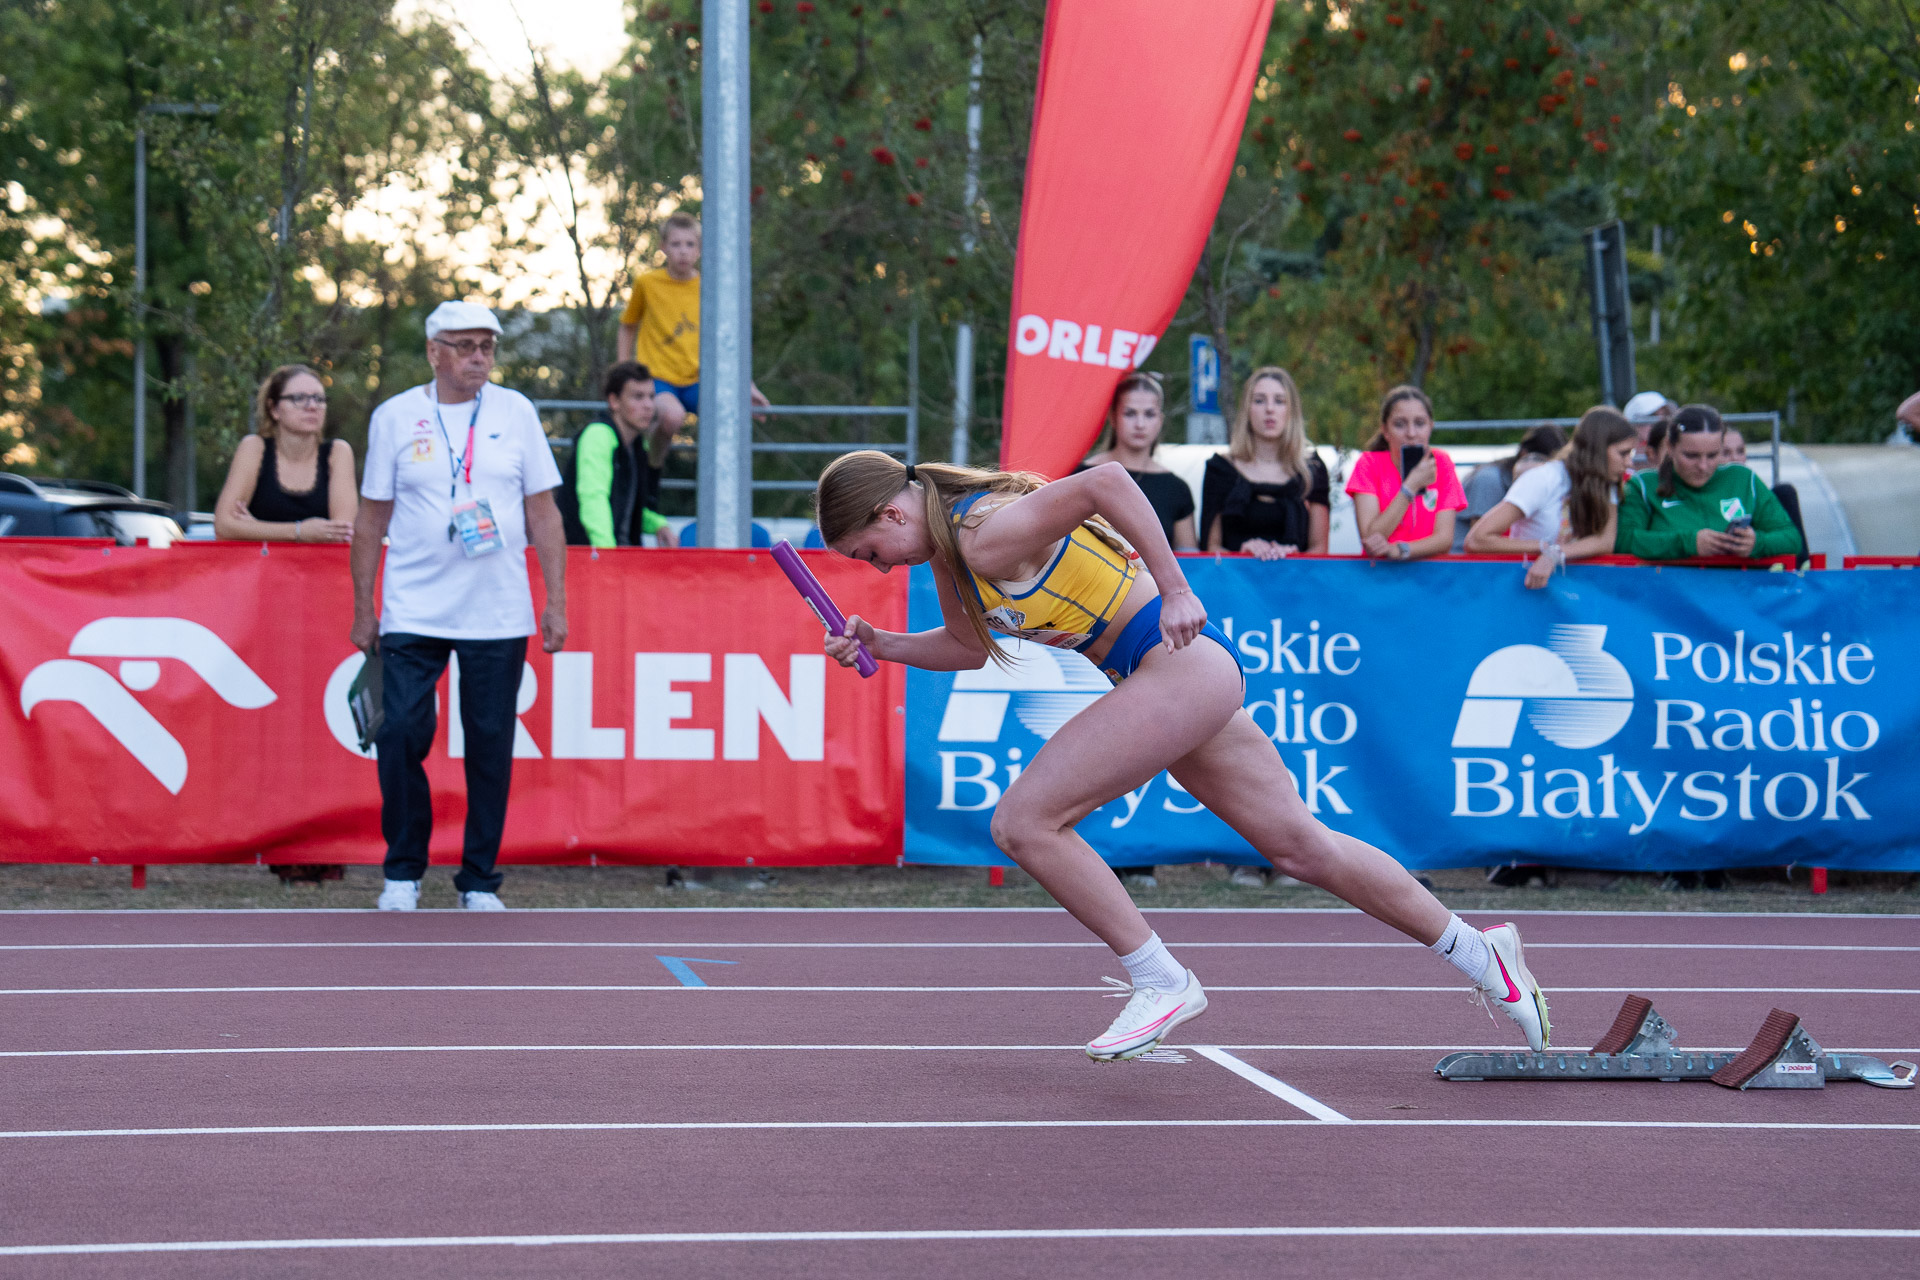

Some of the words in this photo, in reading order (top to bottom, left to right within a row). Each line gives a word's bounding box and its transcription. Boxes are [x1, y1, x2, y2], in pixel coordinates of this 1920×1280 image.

[1197, 345, 1217, 404] P
[1651, 629, 1876, 685] Polskie
[1245, 687, 1358, 745] dio
[1652, 697, 1880, 752] Radio
[1450, 753, 1872, 836] Białystok
